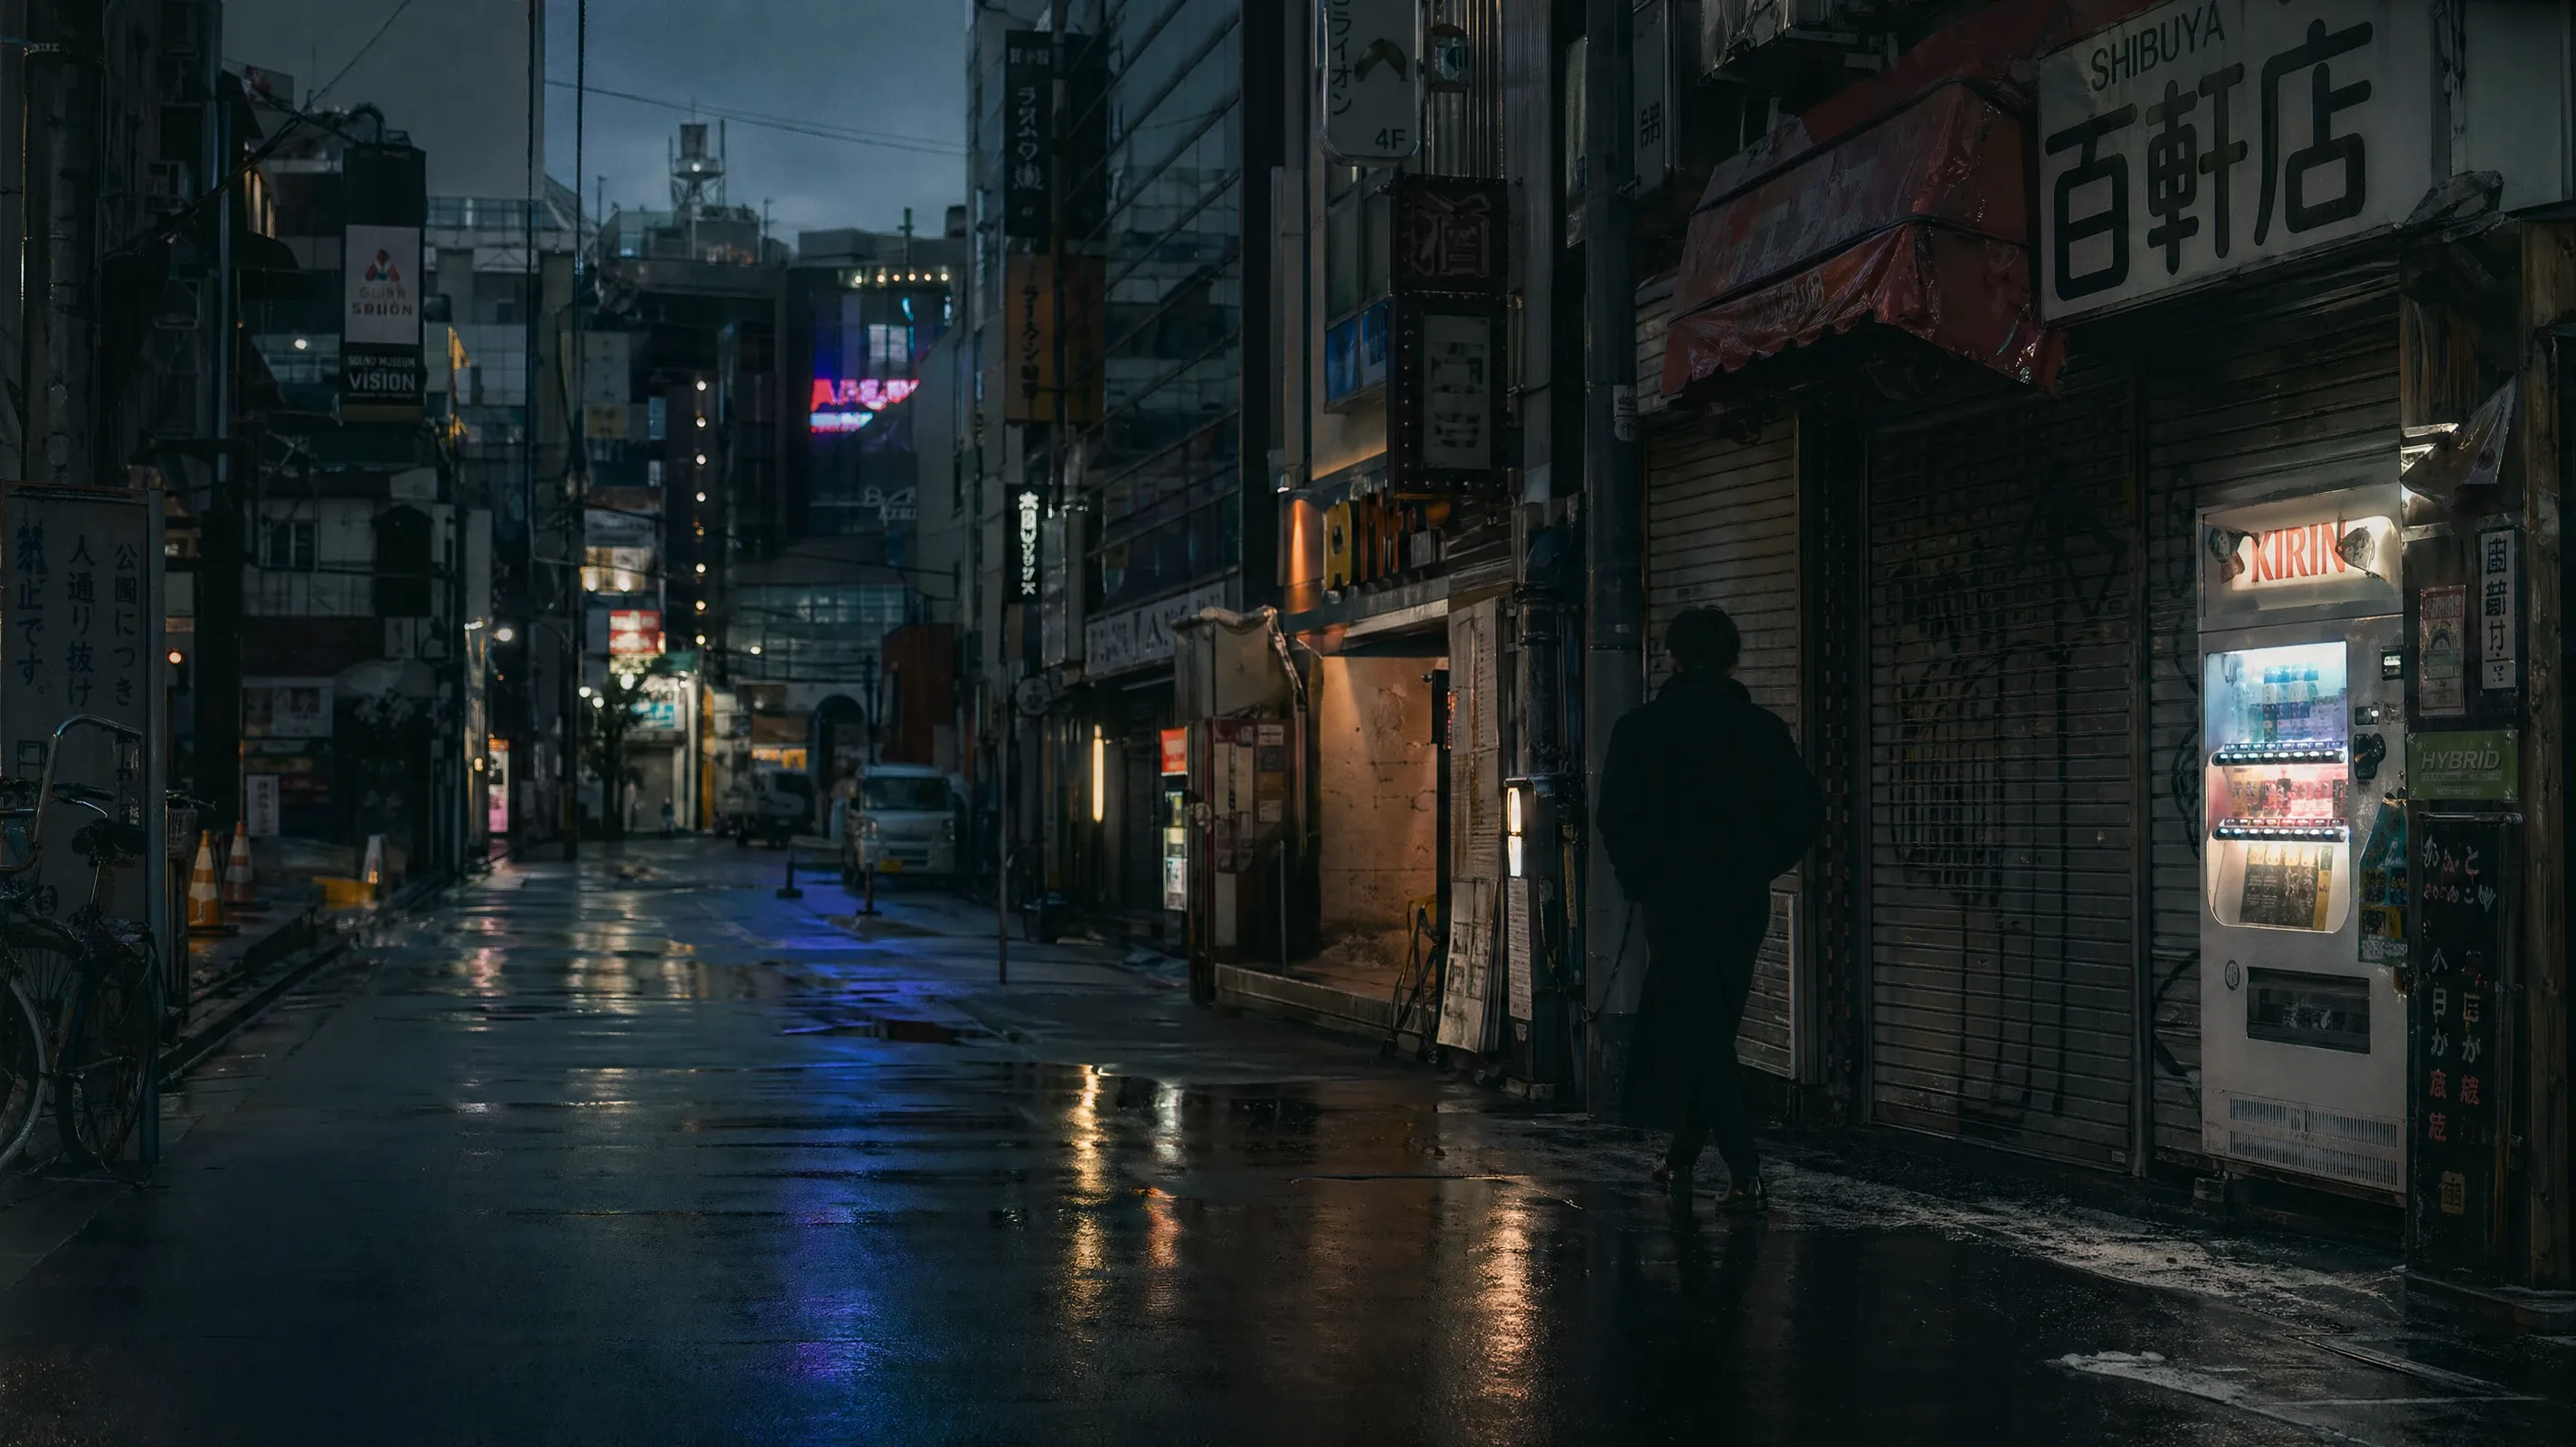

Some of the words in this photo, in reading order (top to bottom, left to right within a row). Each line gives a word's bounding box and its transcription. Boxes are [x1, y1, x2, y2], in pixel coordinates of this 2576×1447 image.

[1331, 0, 1353, 115] ライオン
[2090, 0, 2225, 91] SHIBUYA
[1375, 128, 1406, 149] 4F
[2045, 18, 2373, 302] 百軒店
[348, 372, 416, 391] VISION
[378, 355, 415, 368] MUSEUM
[2250, 519, 2347, 582] KIRIN
[67, 534, 96, 707] 人通り抜け
[2420, 750, 2501, 771] HYBRID
